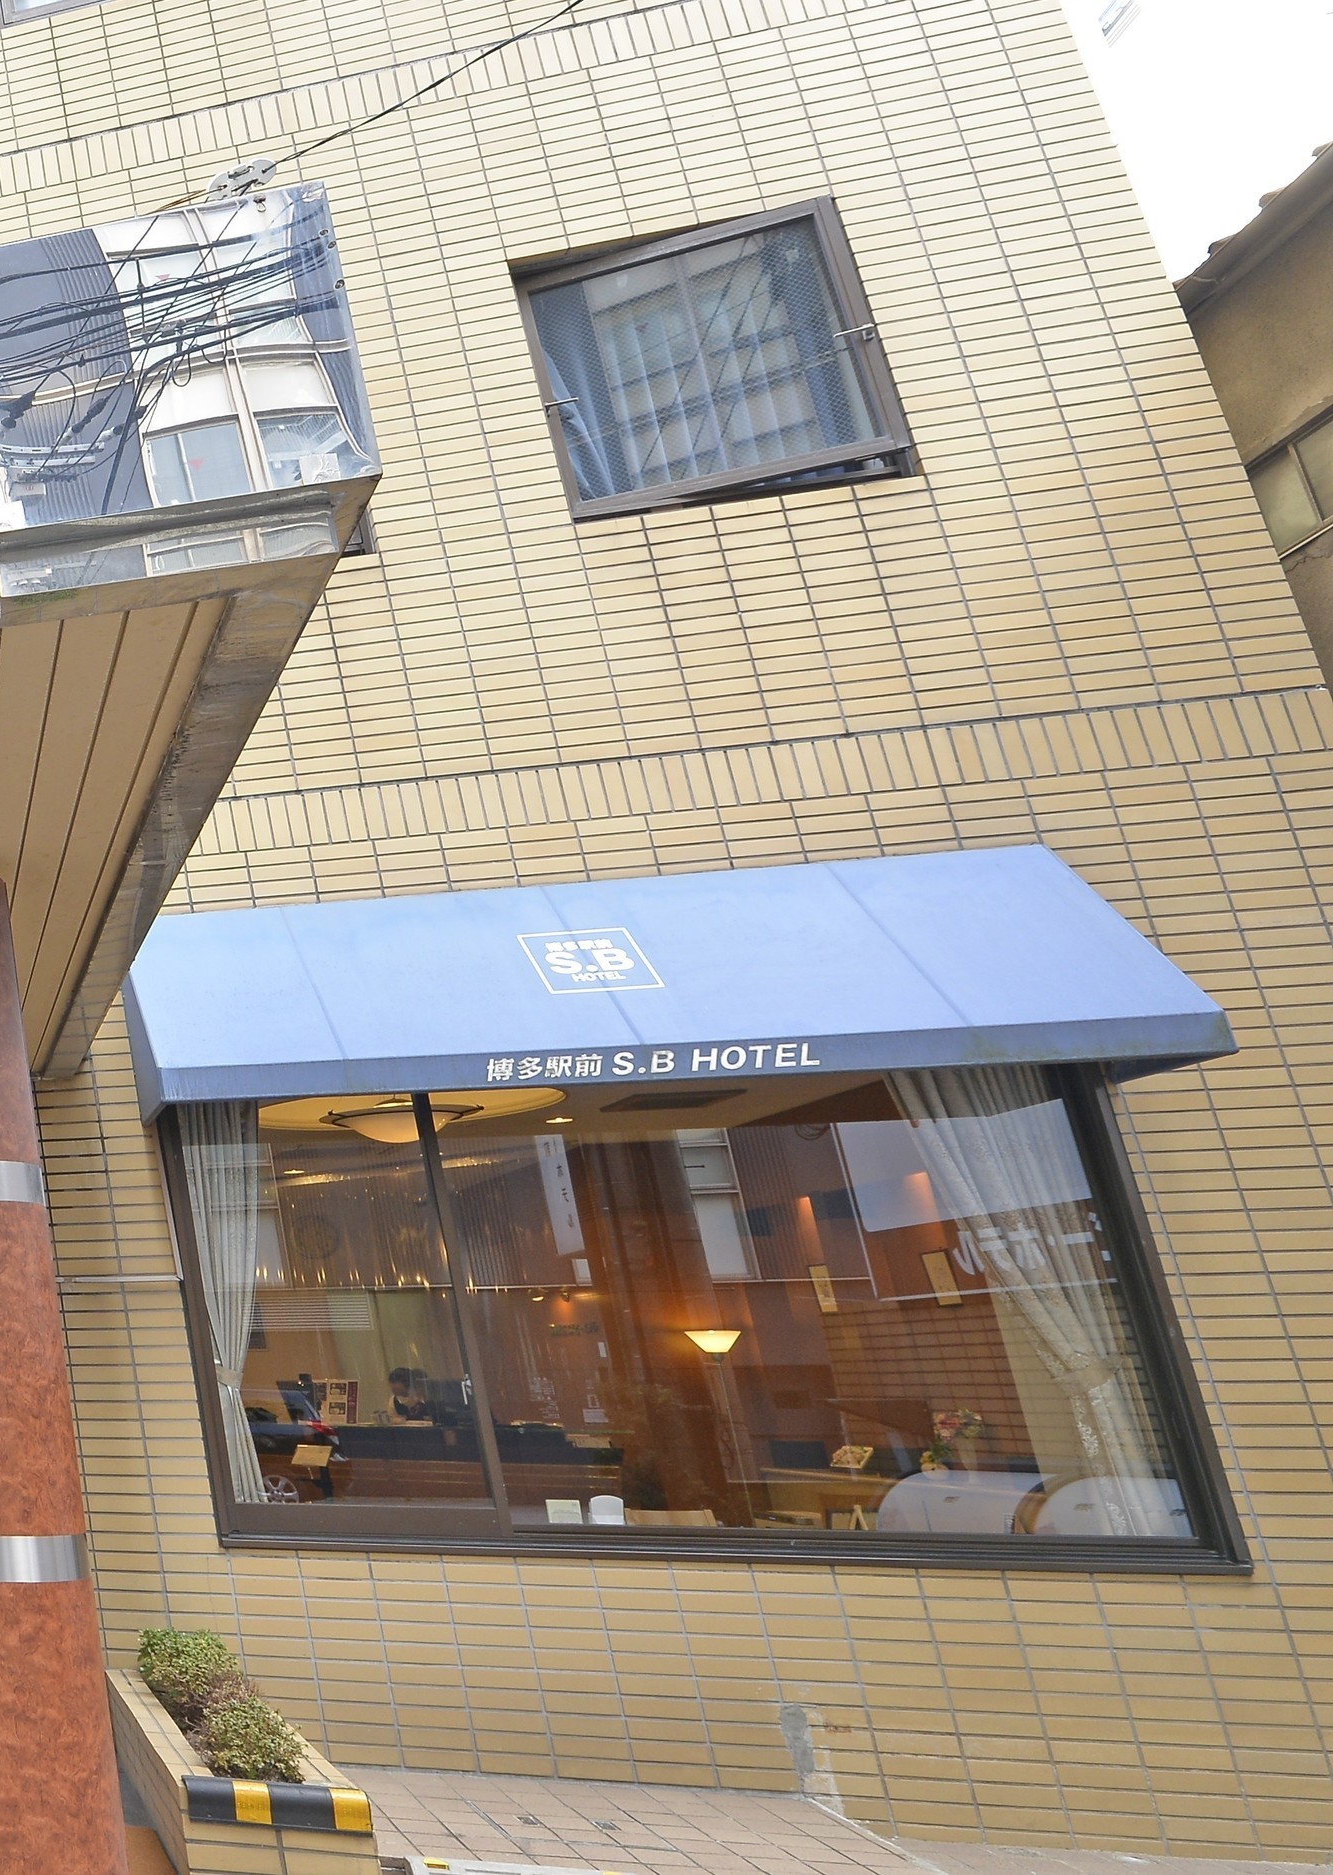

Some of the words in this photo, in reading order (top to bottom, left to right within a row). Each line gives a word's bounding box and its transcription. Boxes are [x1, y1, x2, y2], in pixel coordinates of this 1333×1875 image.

[544, 947, 636, 975] S.B
[571, 971, 627, 983] HOTEL
[486, 1053, 604, 1082] 博多駅前
[611, 1050, 676, 1075] S.B
[690, 1042, 821, 1072] HOTEL
